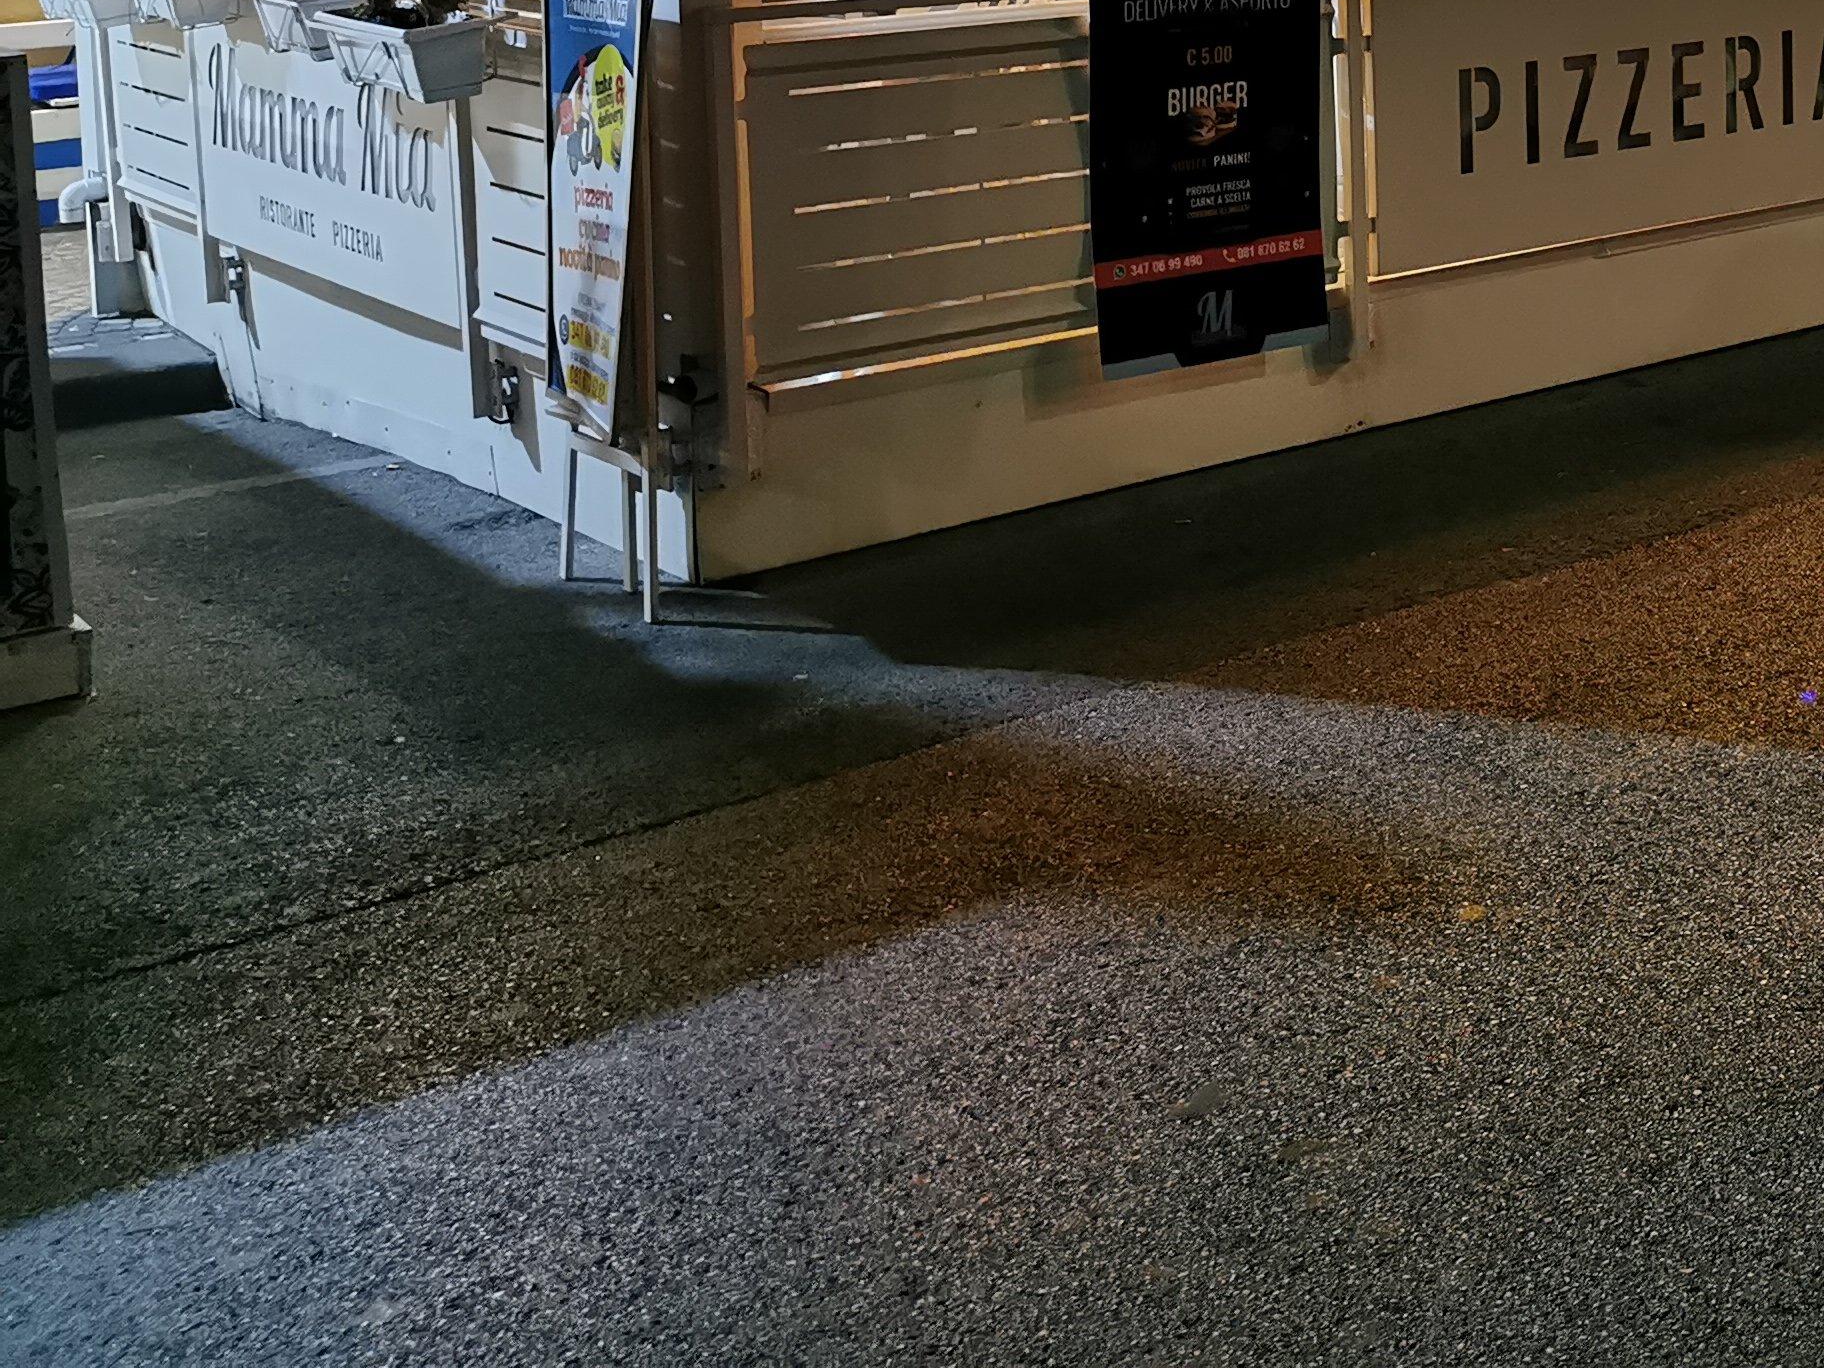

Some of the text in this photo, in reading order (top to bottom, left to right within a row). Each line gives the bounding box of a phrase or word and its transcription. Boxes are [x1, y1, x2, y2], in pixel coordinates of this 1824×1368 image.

[1168, 80, 1248, 117] BURGER
[208, 42, 437, 213] Mamma Mia
[573, 181, 613, 213] pizzeria
[259, 195, 383, 262] RISTORANTE PIZZERIA
[1197, 289, 1234, 338] M
